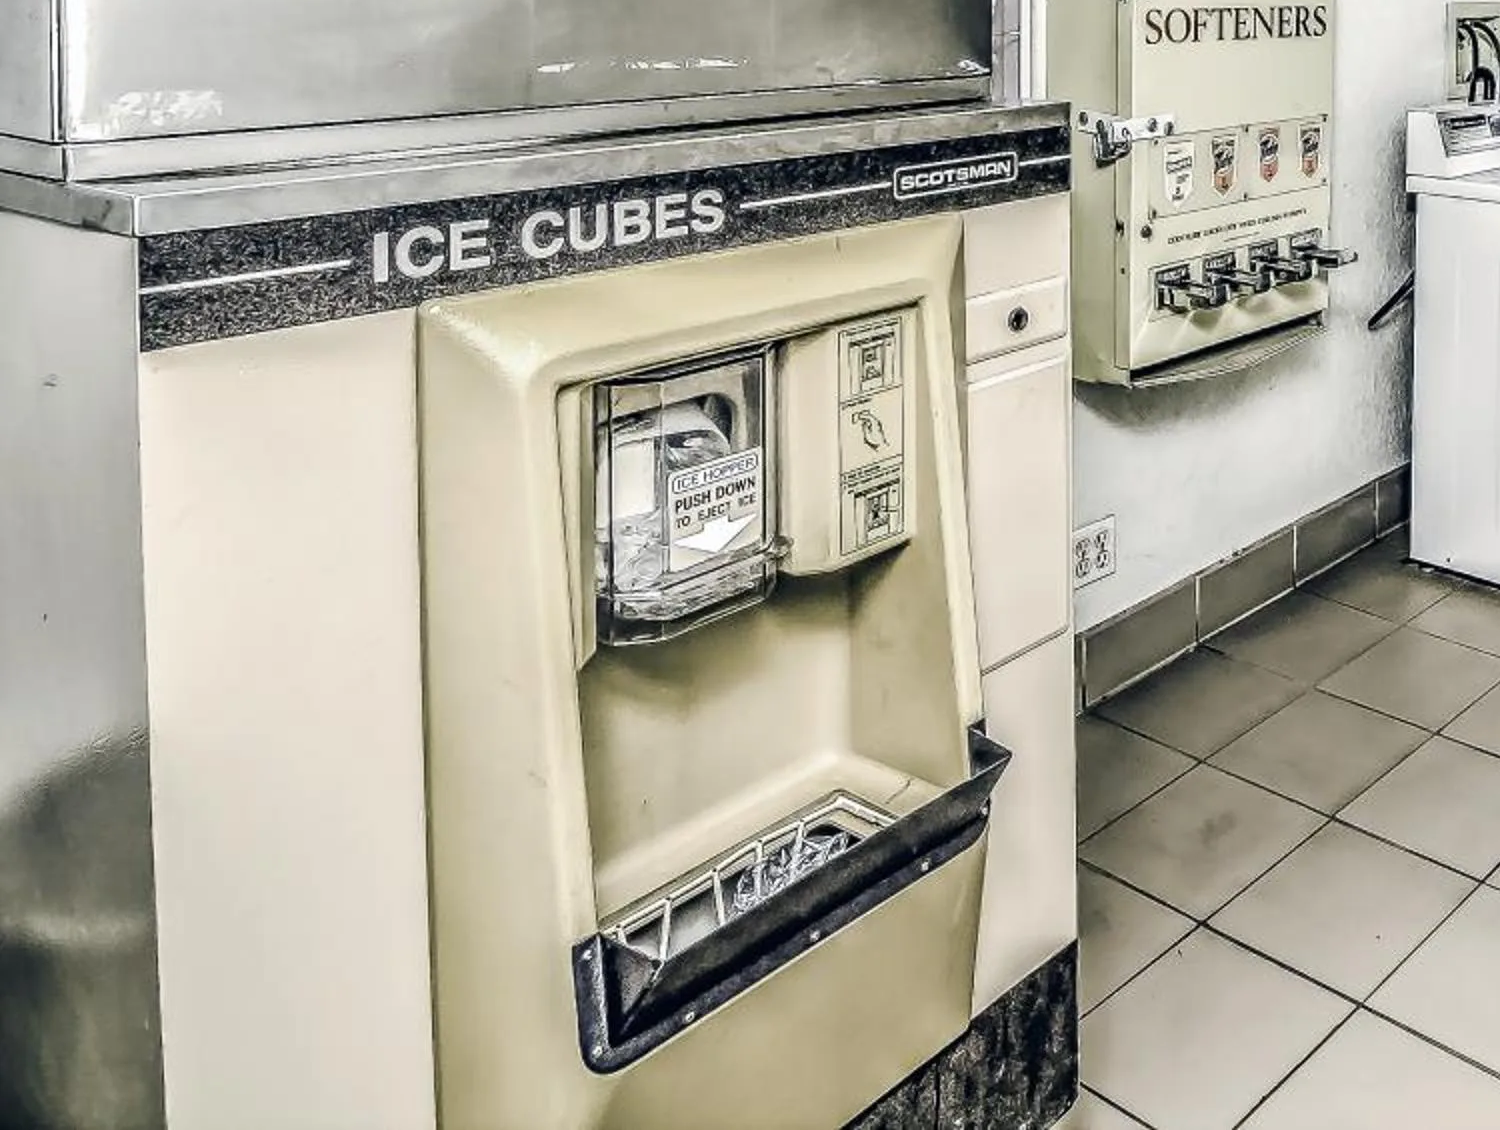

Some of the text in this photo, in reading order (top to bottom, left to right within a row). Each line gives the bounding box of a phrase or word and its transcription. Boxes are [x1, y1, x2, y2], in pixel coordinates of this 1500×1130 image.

[1144, 5, 1327, 45] SOFTENERS
[901, 159, 1011, 190] SCOTSMAN
[373, 189, 725, 283] ICE CUBES
[677, 457, 754, 490] ICE HOPPER
[675, 475, 756, 515] PUSH DOWN
[675, 491, 757, 529] TO EJECT ICE
